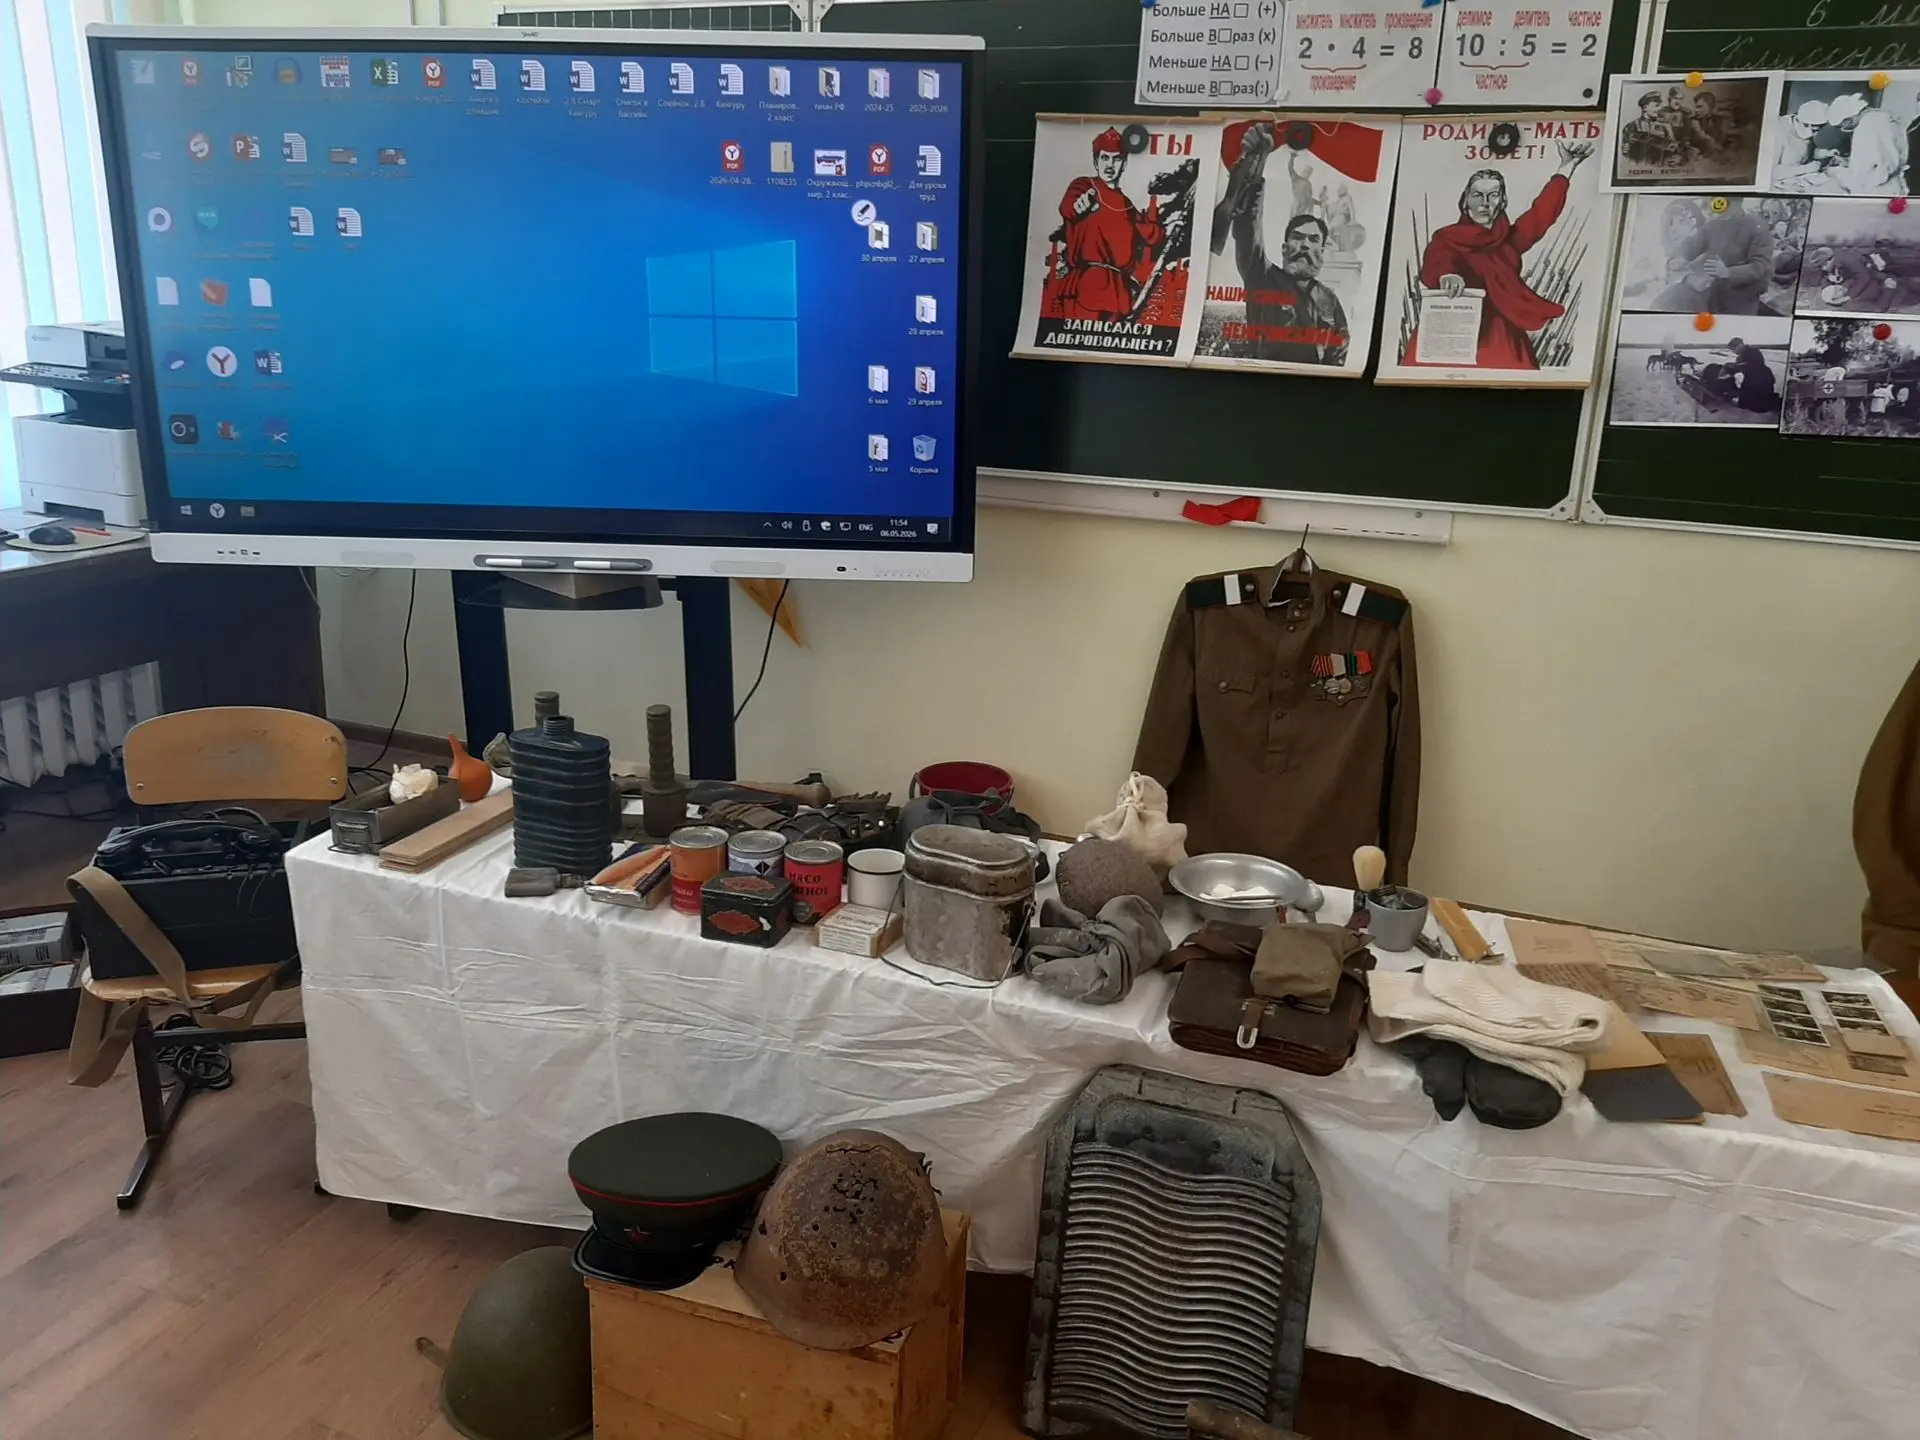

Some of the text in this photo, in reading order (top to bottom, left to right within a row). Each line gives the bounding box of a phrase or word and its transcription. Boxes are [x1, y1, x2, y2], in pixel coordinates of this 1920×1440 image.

[1153, 5, 1206, 17] Больше
[1210, 3, 1230, 16] НА
[1151, 30, 1204, 43] Больше
[1209, 29, 1217, 41] В
[1233, 34, 1254, 44] раз
[1298, 37, 1313, 59] 2
[1352, 37, 1366, 59] 4
[1408, 36, 1423, 59] 8
[1456, 34, 1485, 56] 10
[1521, 34, 1537, 56] 5
[1581, 34, 1598, 56] 2
[1149, 56, 1207, 69] Меньше
[1211, 55, 1231, 68] НА
[1147, 81, 1205, 94] Меньше
[1210, 81, 1218, 93] В
[1422, 121, 1601, 141] РОДИ-МАТЬ
[1149, 133, 1193, 156] ТЫ
[1207, 285, 1248, 302] НАШИ
[918, 329, 944, 337] апреля
[1063, 317, 1153, 336] ЗАПИСАЛСЯ
[917, 399, 943, 407] апреля
[909, 466, 939, 475] Корзина
[858, 523, 874, 532] ENG
[889, 519, 908, 527] 11:54
[880, 530, 918, 538] 06.05.2026
